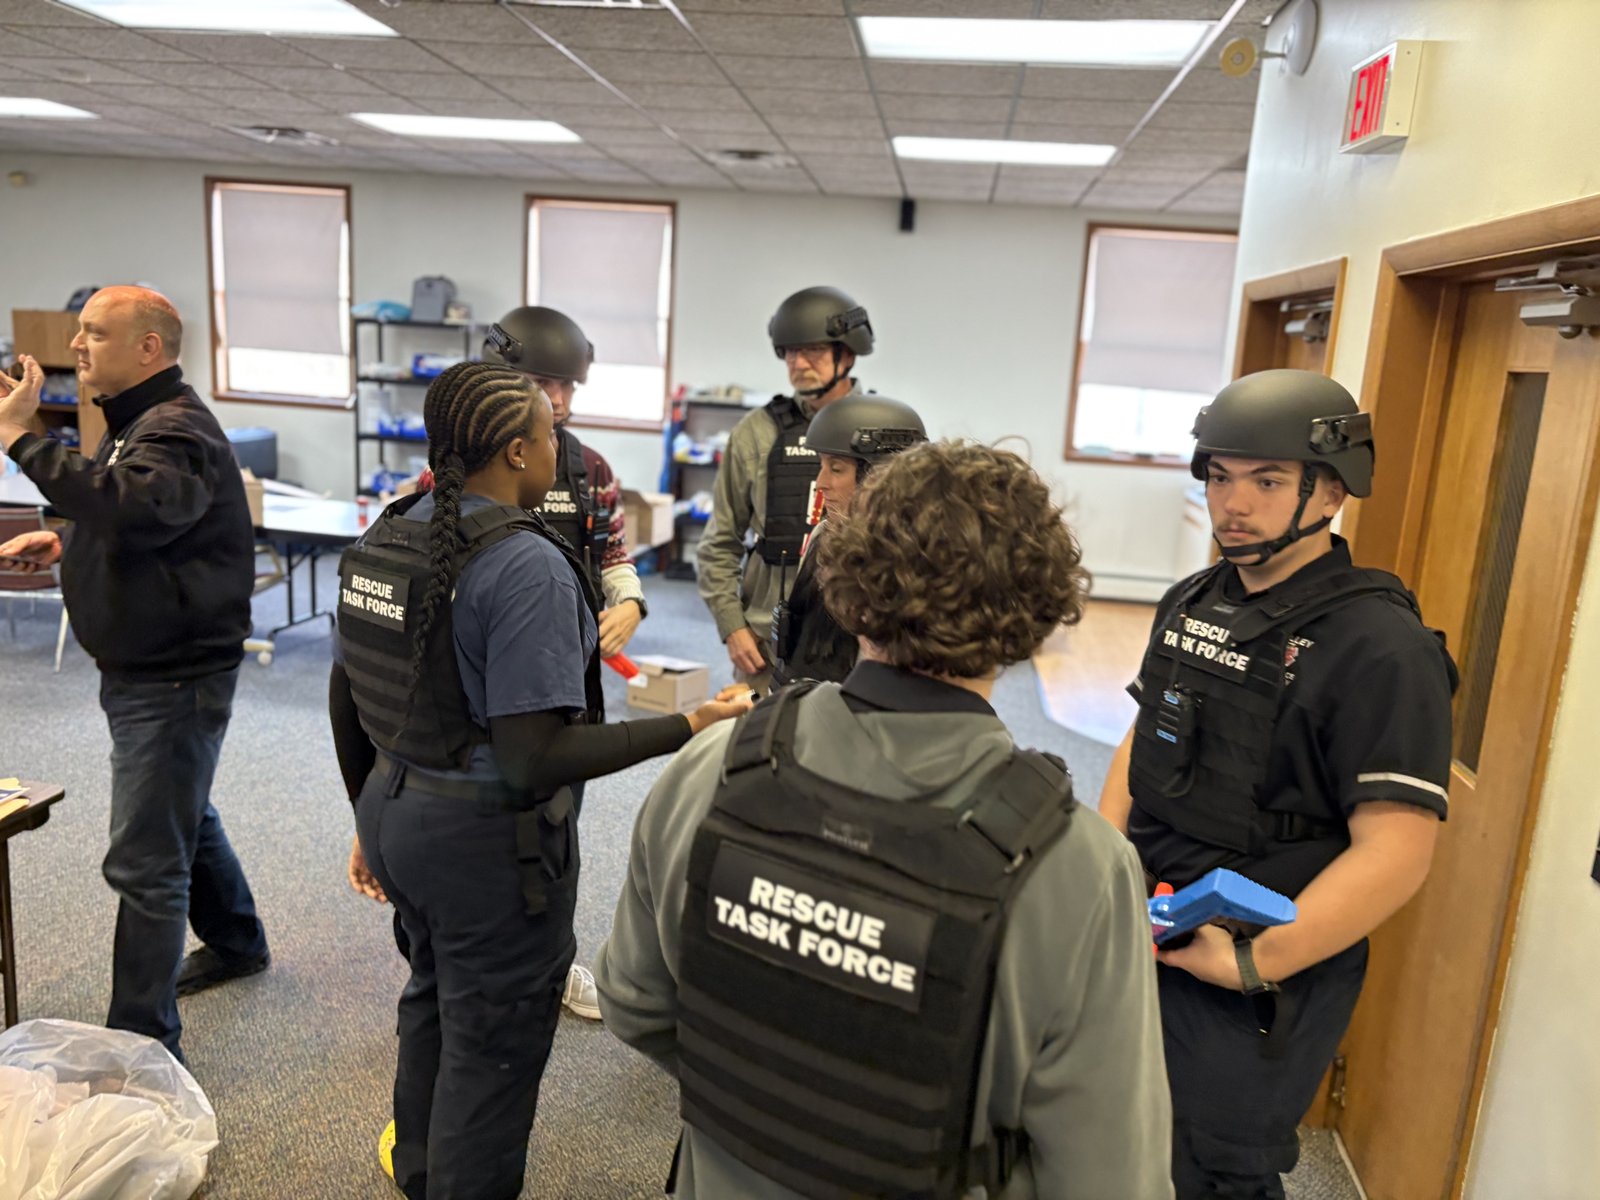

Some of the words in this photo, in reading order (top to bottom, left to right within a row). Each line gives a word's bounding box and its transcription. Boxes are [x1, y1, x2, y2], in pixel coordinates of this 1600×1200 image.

[1349, 54, 1390, 142] EXIT
[544, 502, 577, 513] FORC
[545, 491, 571, 501] CUE
[351, 574, 393, 599] RESCUE
[342, 588, 365, 609] TASK
[366, 597, 405, 621] FORCE
[1183, 617, 1236, 647] RESCU
[749, 876, 886, 949] RESCUE
[714, 896, 792, 950] TASK
[797, 928, 916, 993] FORCE
